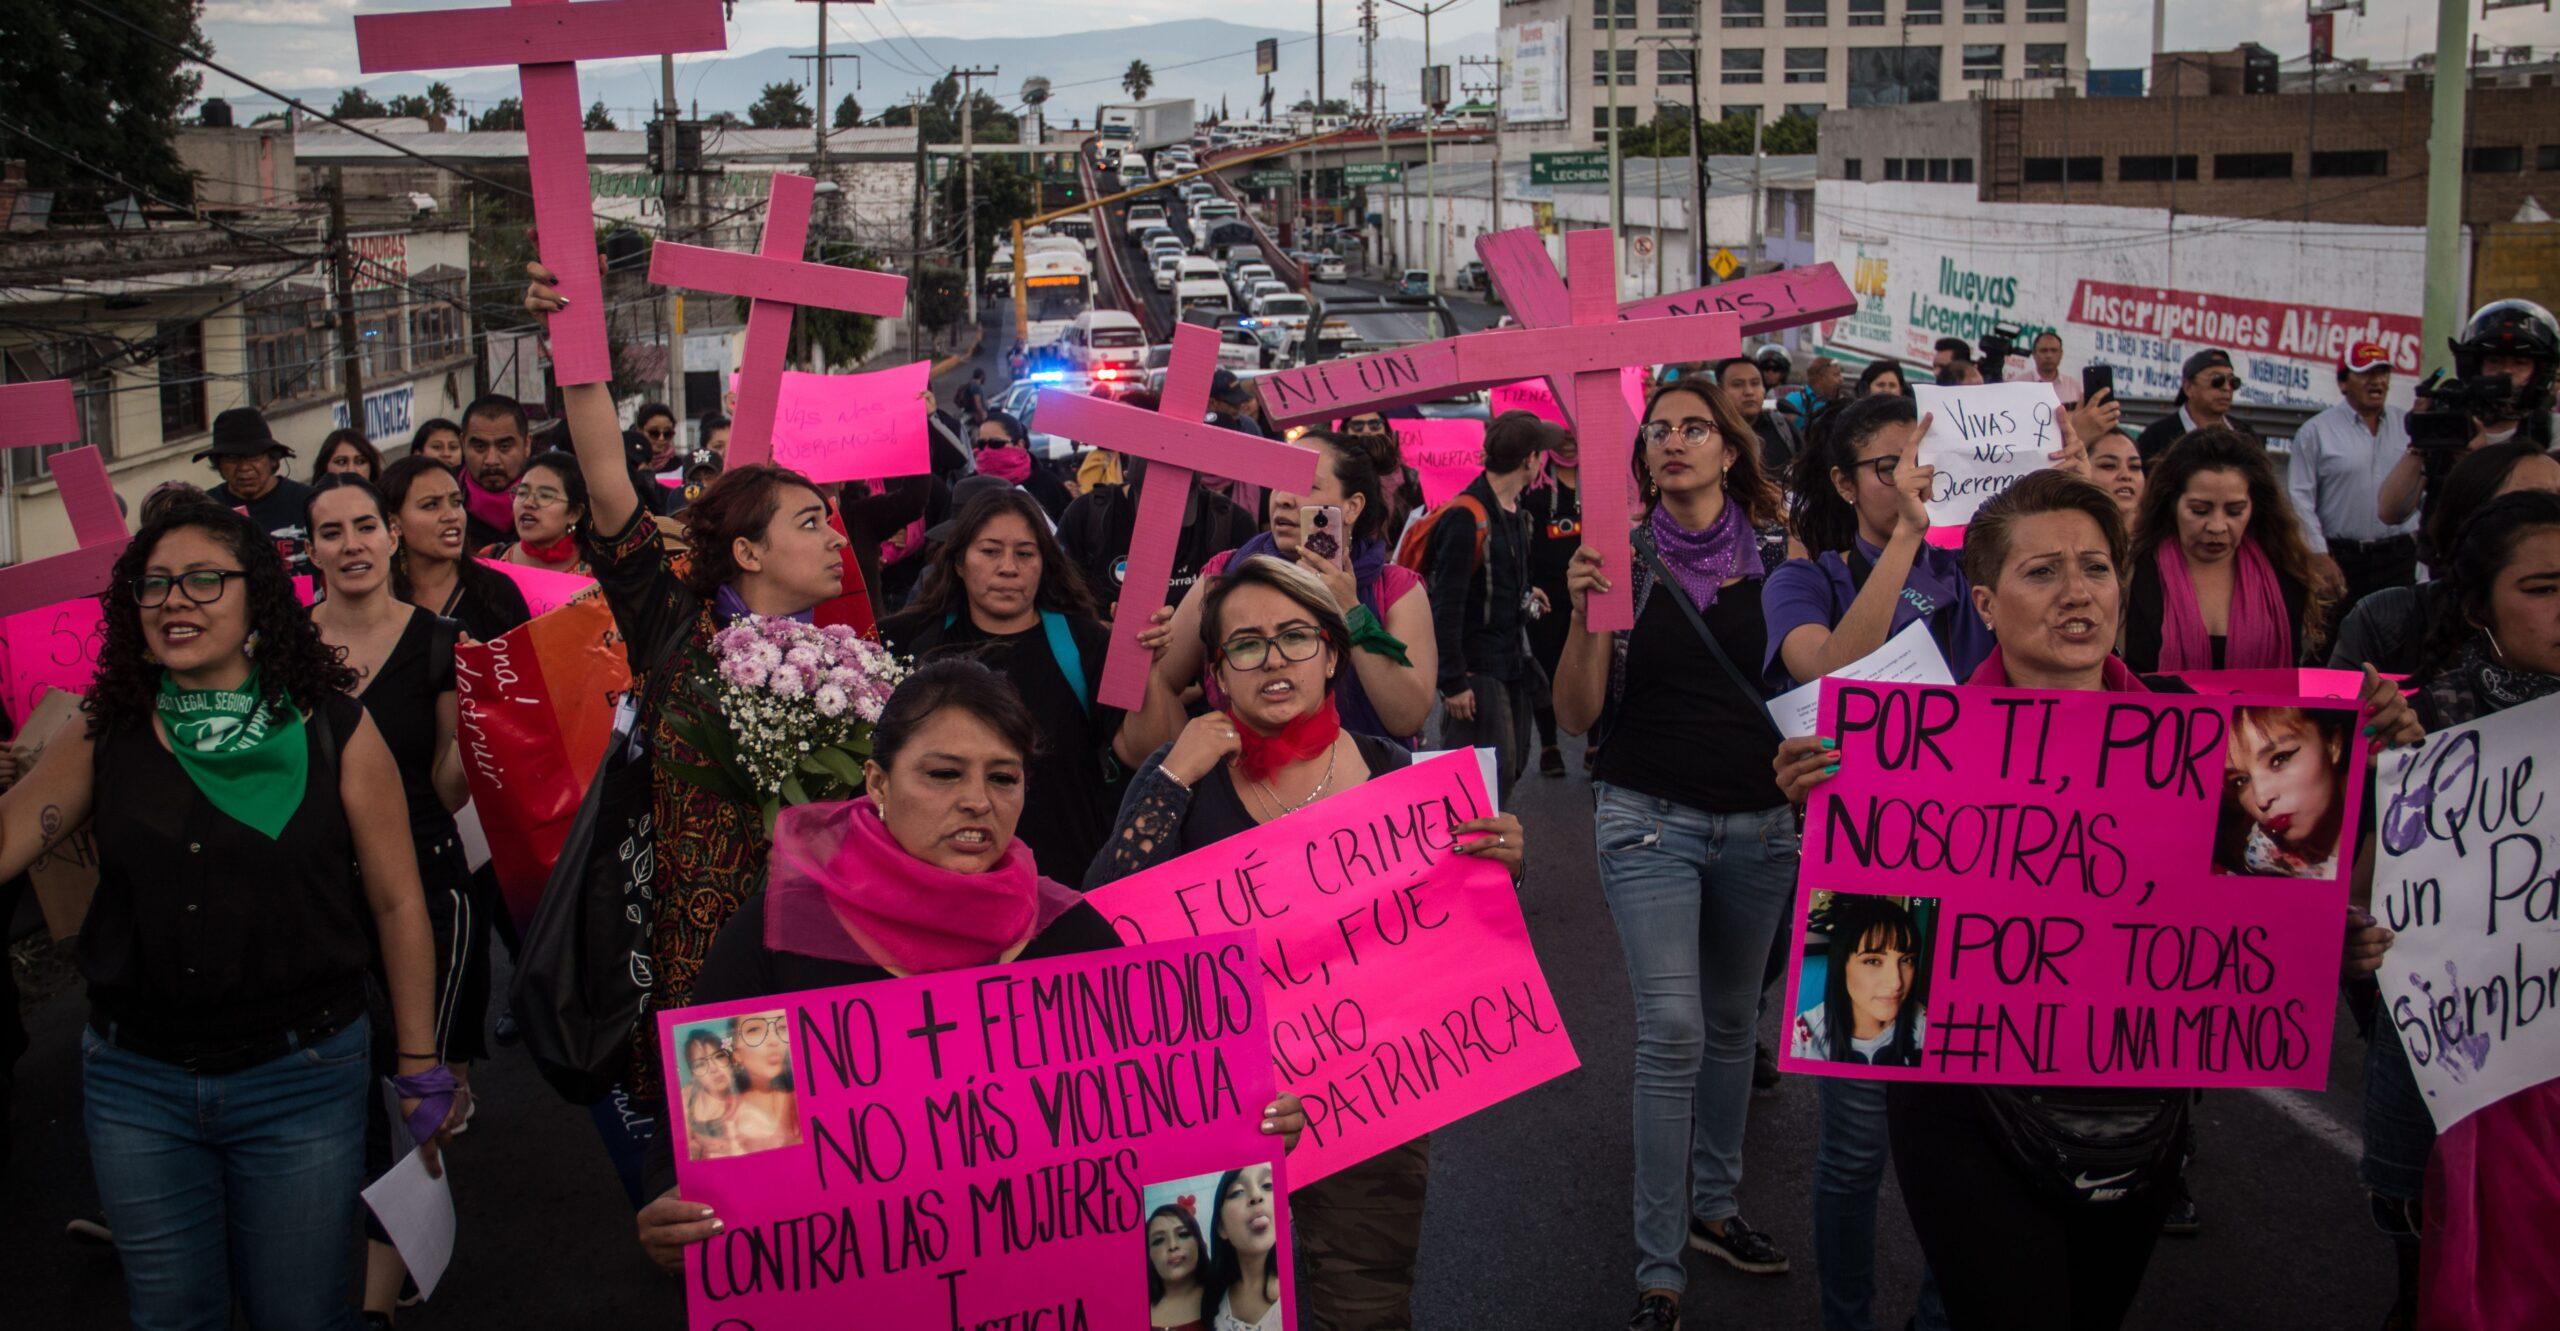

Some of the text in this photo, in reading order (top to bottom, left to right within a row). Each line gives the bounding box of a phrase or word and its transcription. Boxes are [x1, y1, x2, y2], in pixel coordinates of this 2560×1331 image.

[1552, 169, 1609, 181] LECHERIA
[1855, 256, 1888, 298] UNE
[1938, 254, 2018, 308] Nuevas
[1909, 290, 2057, 352] Licenciatra
[2082, 284, 2271, 348] Inscripciones
[1942, 398, 2017, 441] VIVAS
[1972, 443, 2017, 464] NOS
[1930, 470, 2026, 503] Querem
[175, 692, 214, 714] LEGAL,
[215, 692, 254, 714] SEGURO
[1834, 685, 2226, 801] POR TI, POR
[1173, 848, 1290, 937] FUÉ
[1304, 771, 1481, 897] CRIMEN
[1824, 793, 2157, 907] NOSOTRAS,
[1336, 869, 1452, 967] FUÉ
[2384, 875, 2442, 933] un
[1949, 911, 2277, 995] POR TODAS
[797, 943, 1255, 1098] NO + FEMINICIDIOS
[1929, 997, 2311, 1074] #NI UNA MENOS
[810, 1044, 1243, 1192] NO MÁS VIOLENCIA
[699, 1146, 1144, 1302] CONTRA LAS MUJERES
